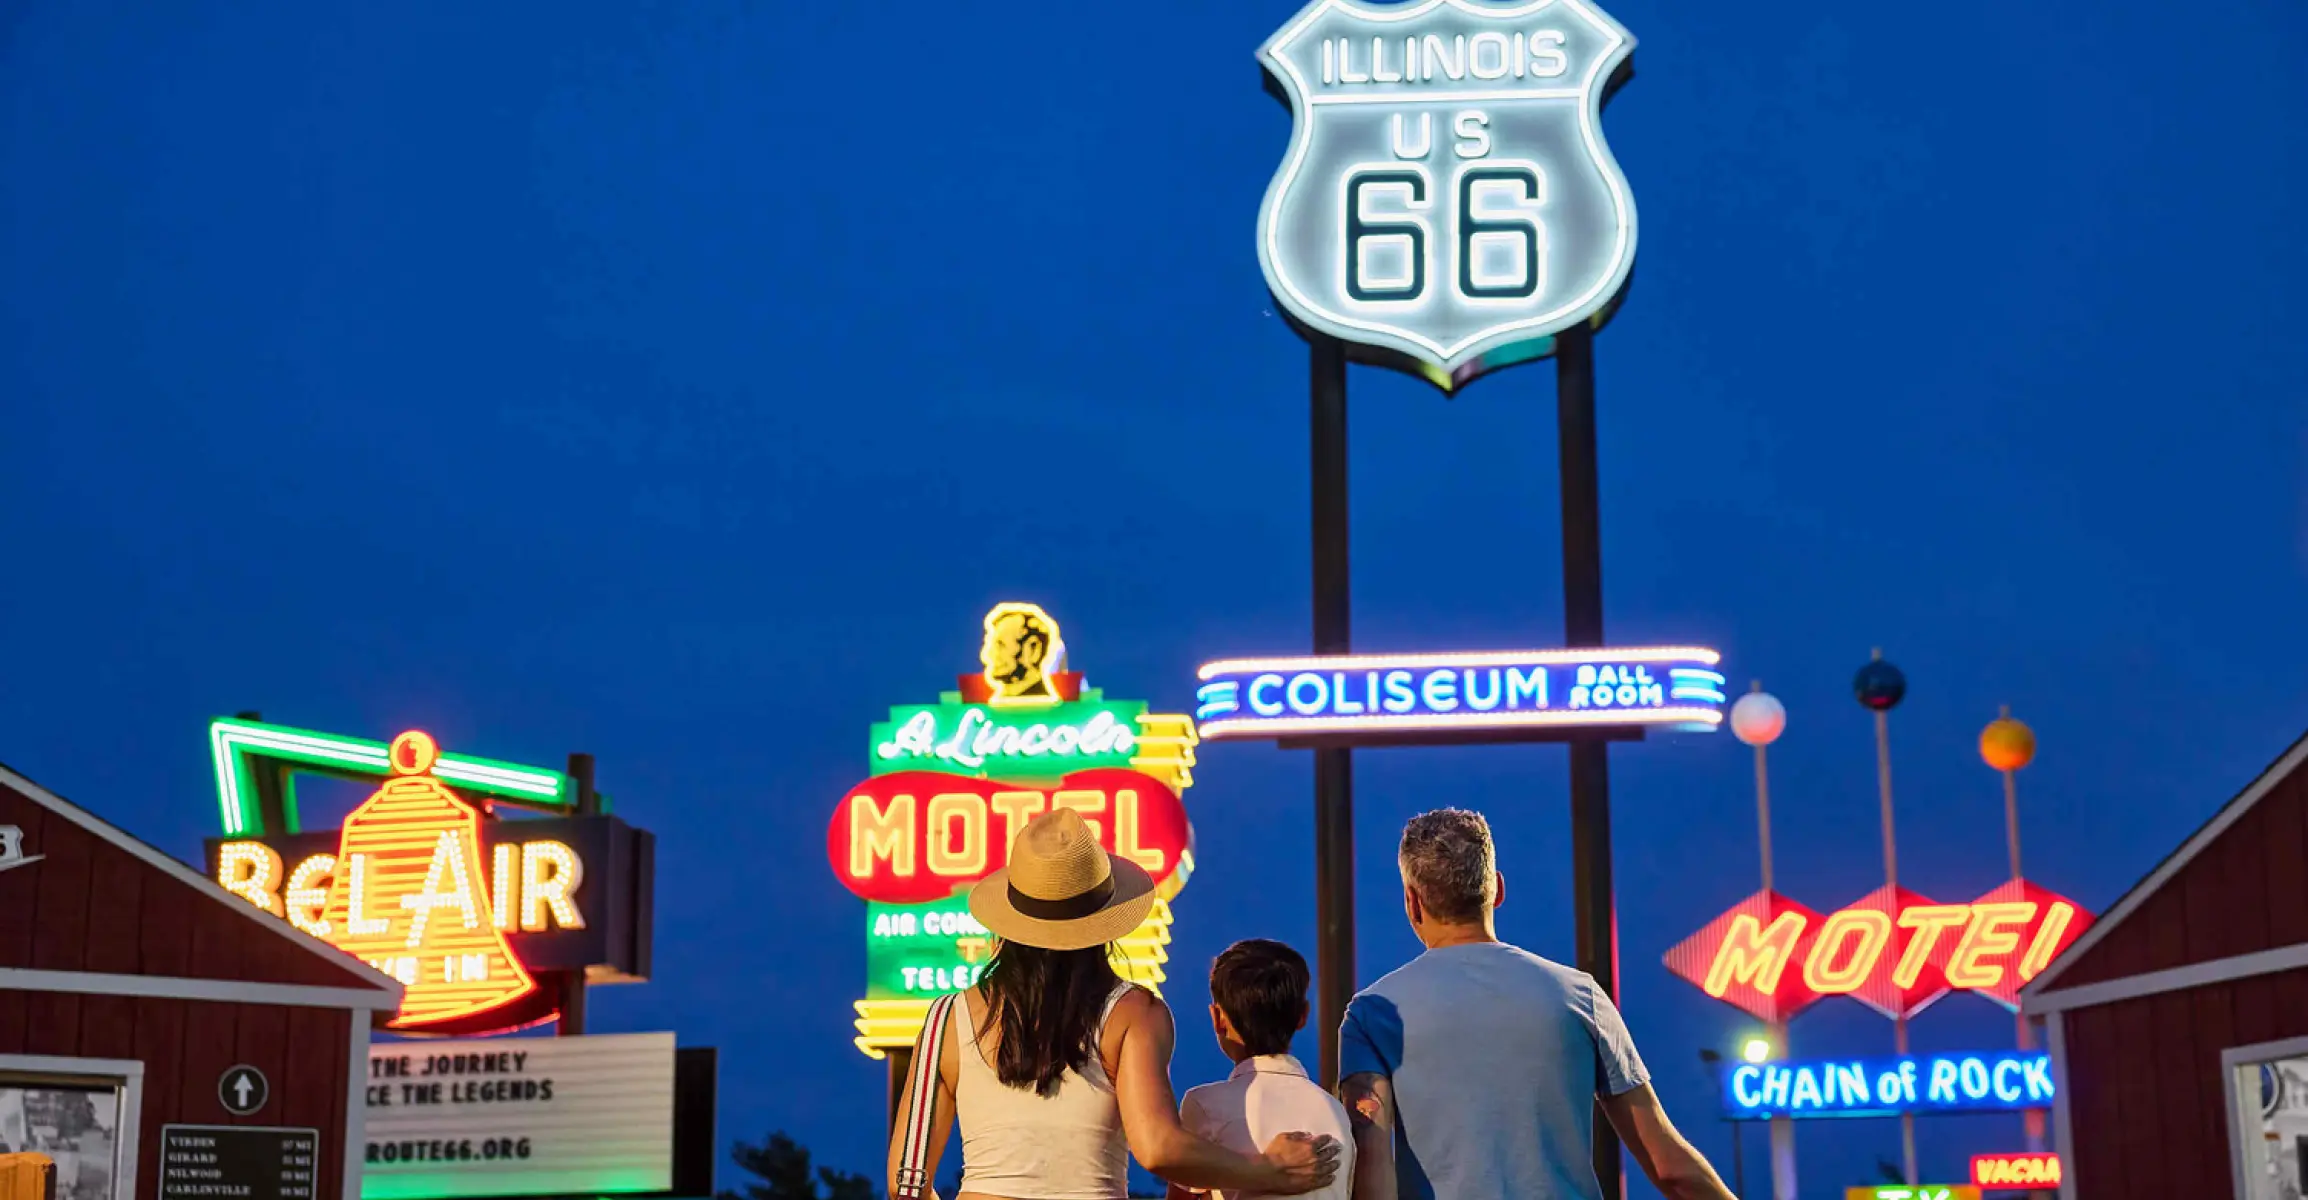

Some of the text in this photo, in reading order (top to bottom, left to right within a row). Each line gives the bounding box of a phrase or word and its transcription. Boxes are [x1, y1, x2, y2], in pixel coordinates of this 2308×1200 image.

[1322, 30, 1568, 84] ILLINOIS
[1341, 160, 1546, 309] 66
[1247, 665, 1548, 716] COLISEUM
[1576, 664, 1654, 686] BALL
[1568, 685, 1663, 709] ROOM
[935, 707, 1136, 768] Lincoln
[873, 912, 916, 937] AIR
[370, 1051, 528, 1078] THE JOURNEY
[1732, 1056, 2055, 1109] CHAIN of ROCK
[401, 1083, 442, 1105] THE
[451, 1079, 554, 1103] LEGENDS
